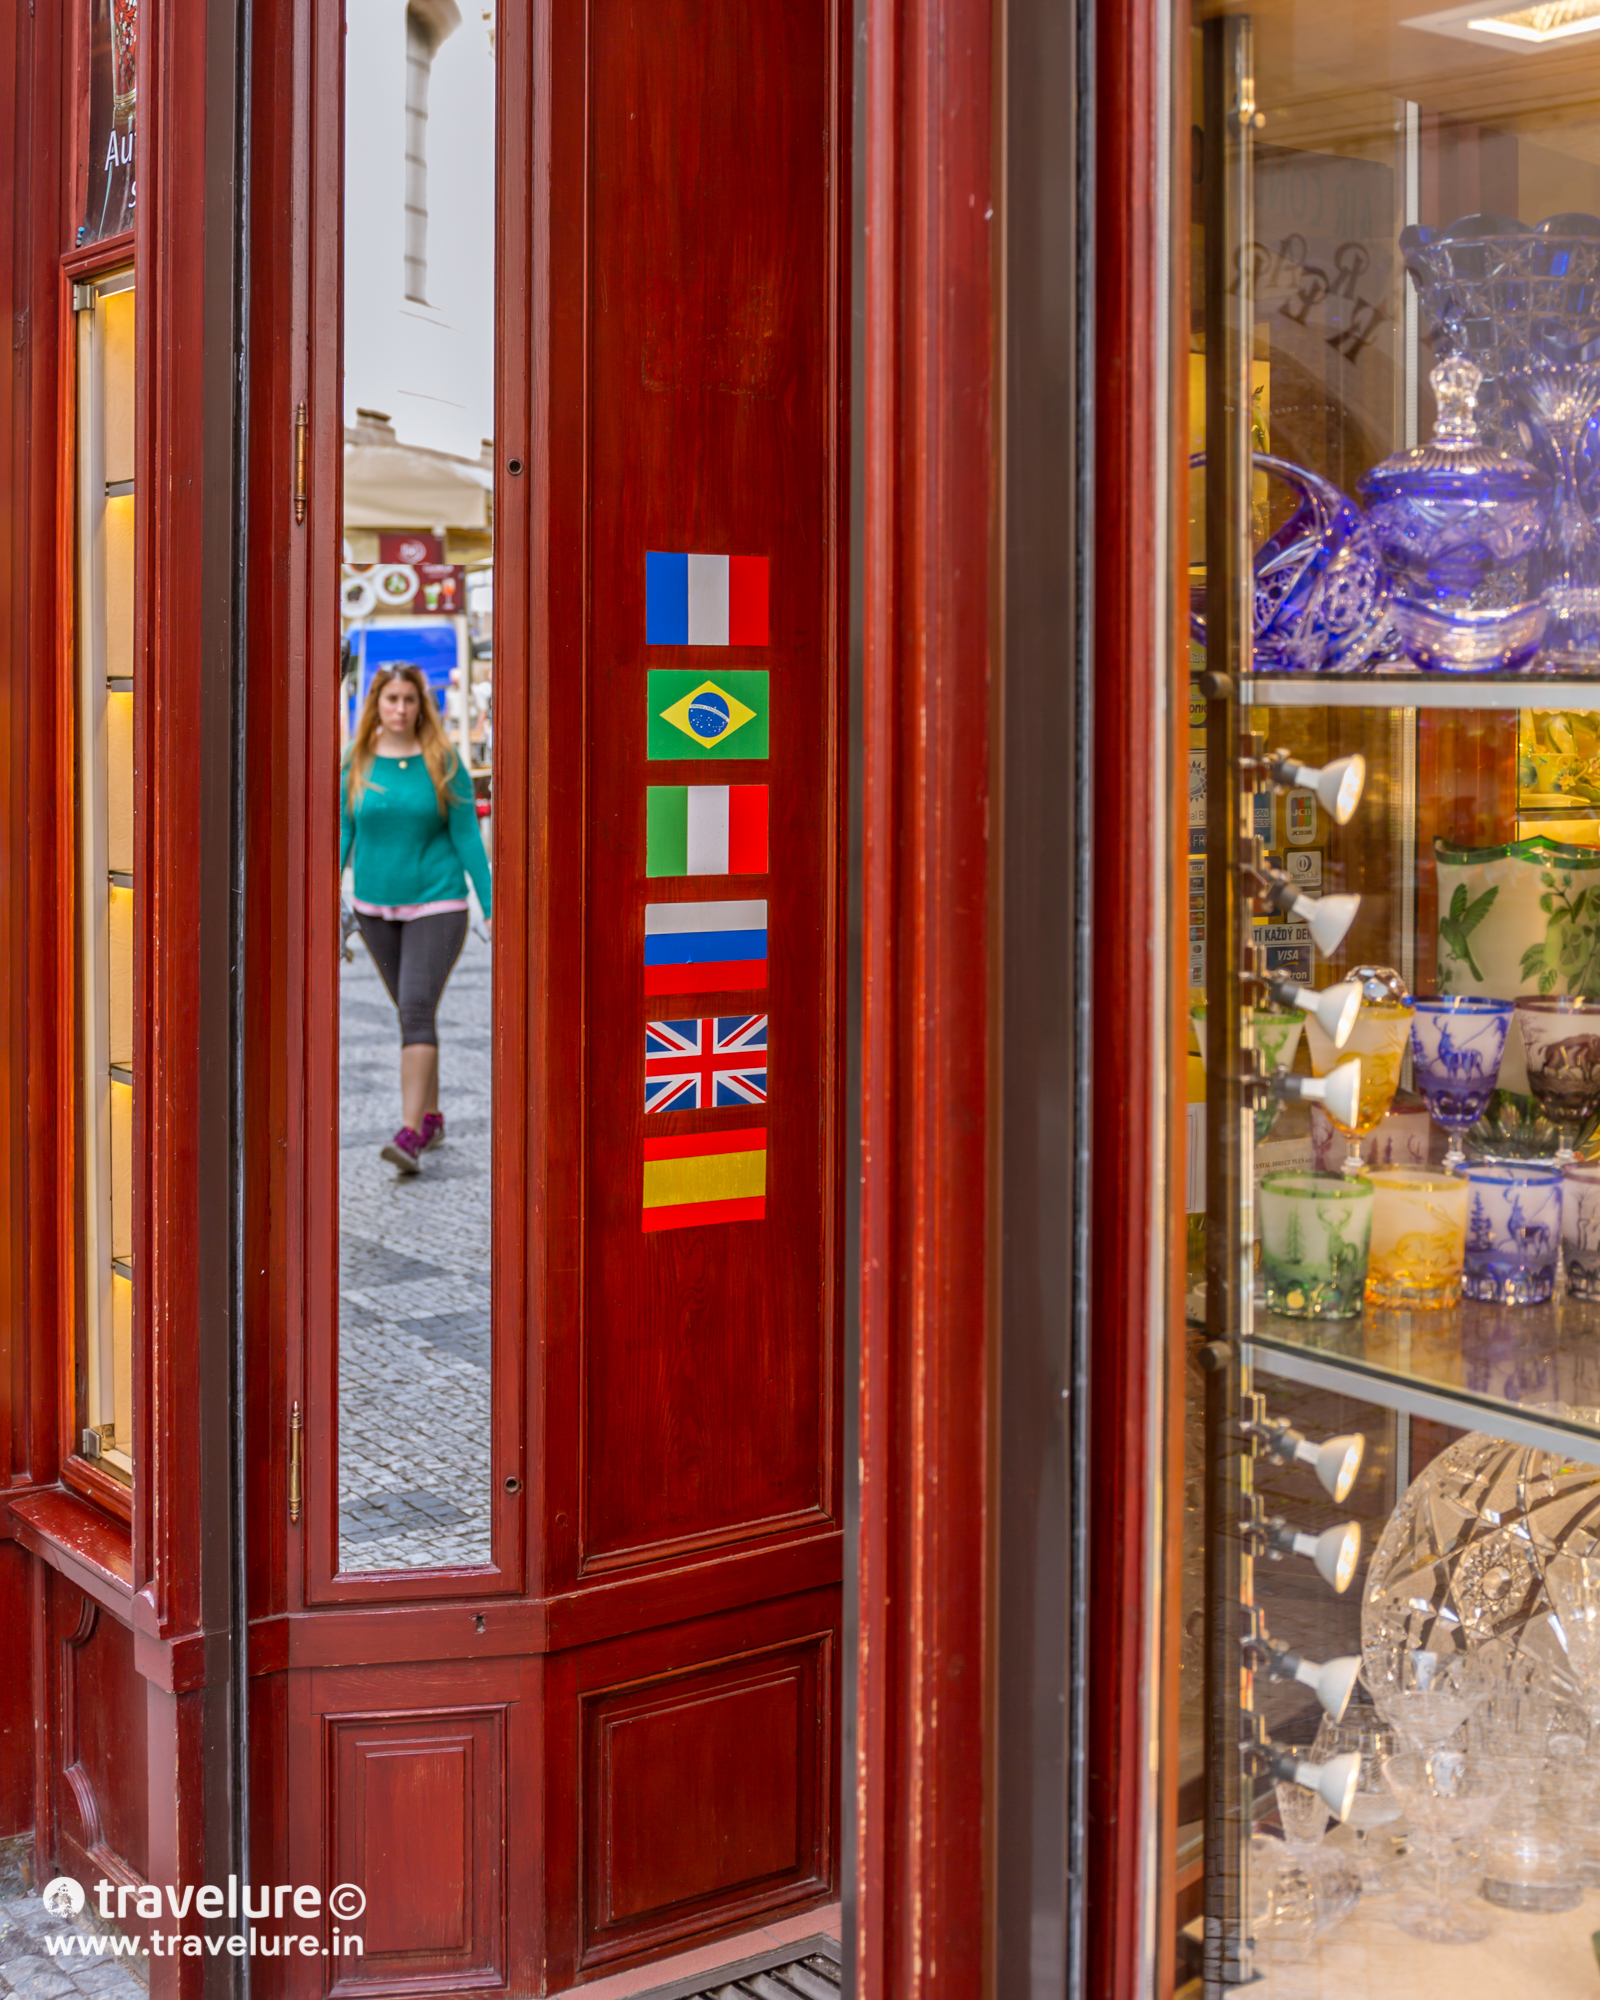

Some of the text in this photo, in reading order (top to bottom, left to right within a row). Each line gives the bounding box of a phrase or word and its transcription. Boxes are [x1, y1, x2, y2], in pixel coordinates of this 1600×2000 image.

[104, 129, 137, 171] Au
[1291, 808, 1311, 816] JCB
[1265, 927, 1293, 941] KAŽDÝ
[1277, 950, 1299, 960] VISA
